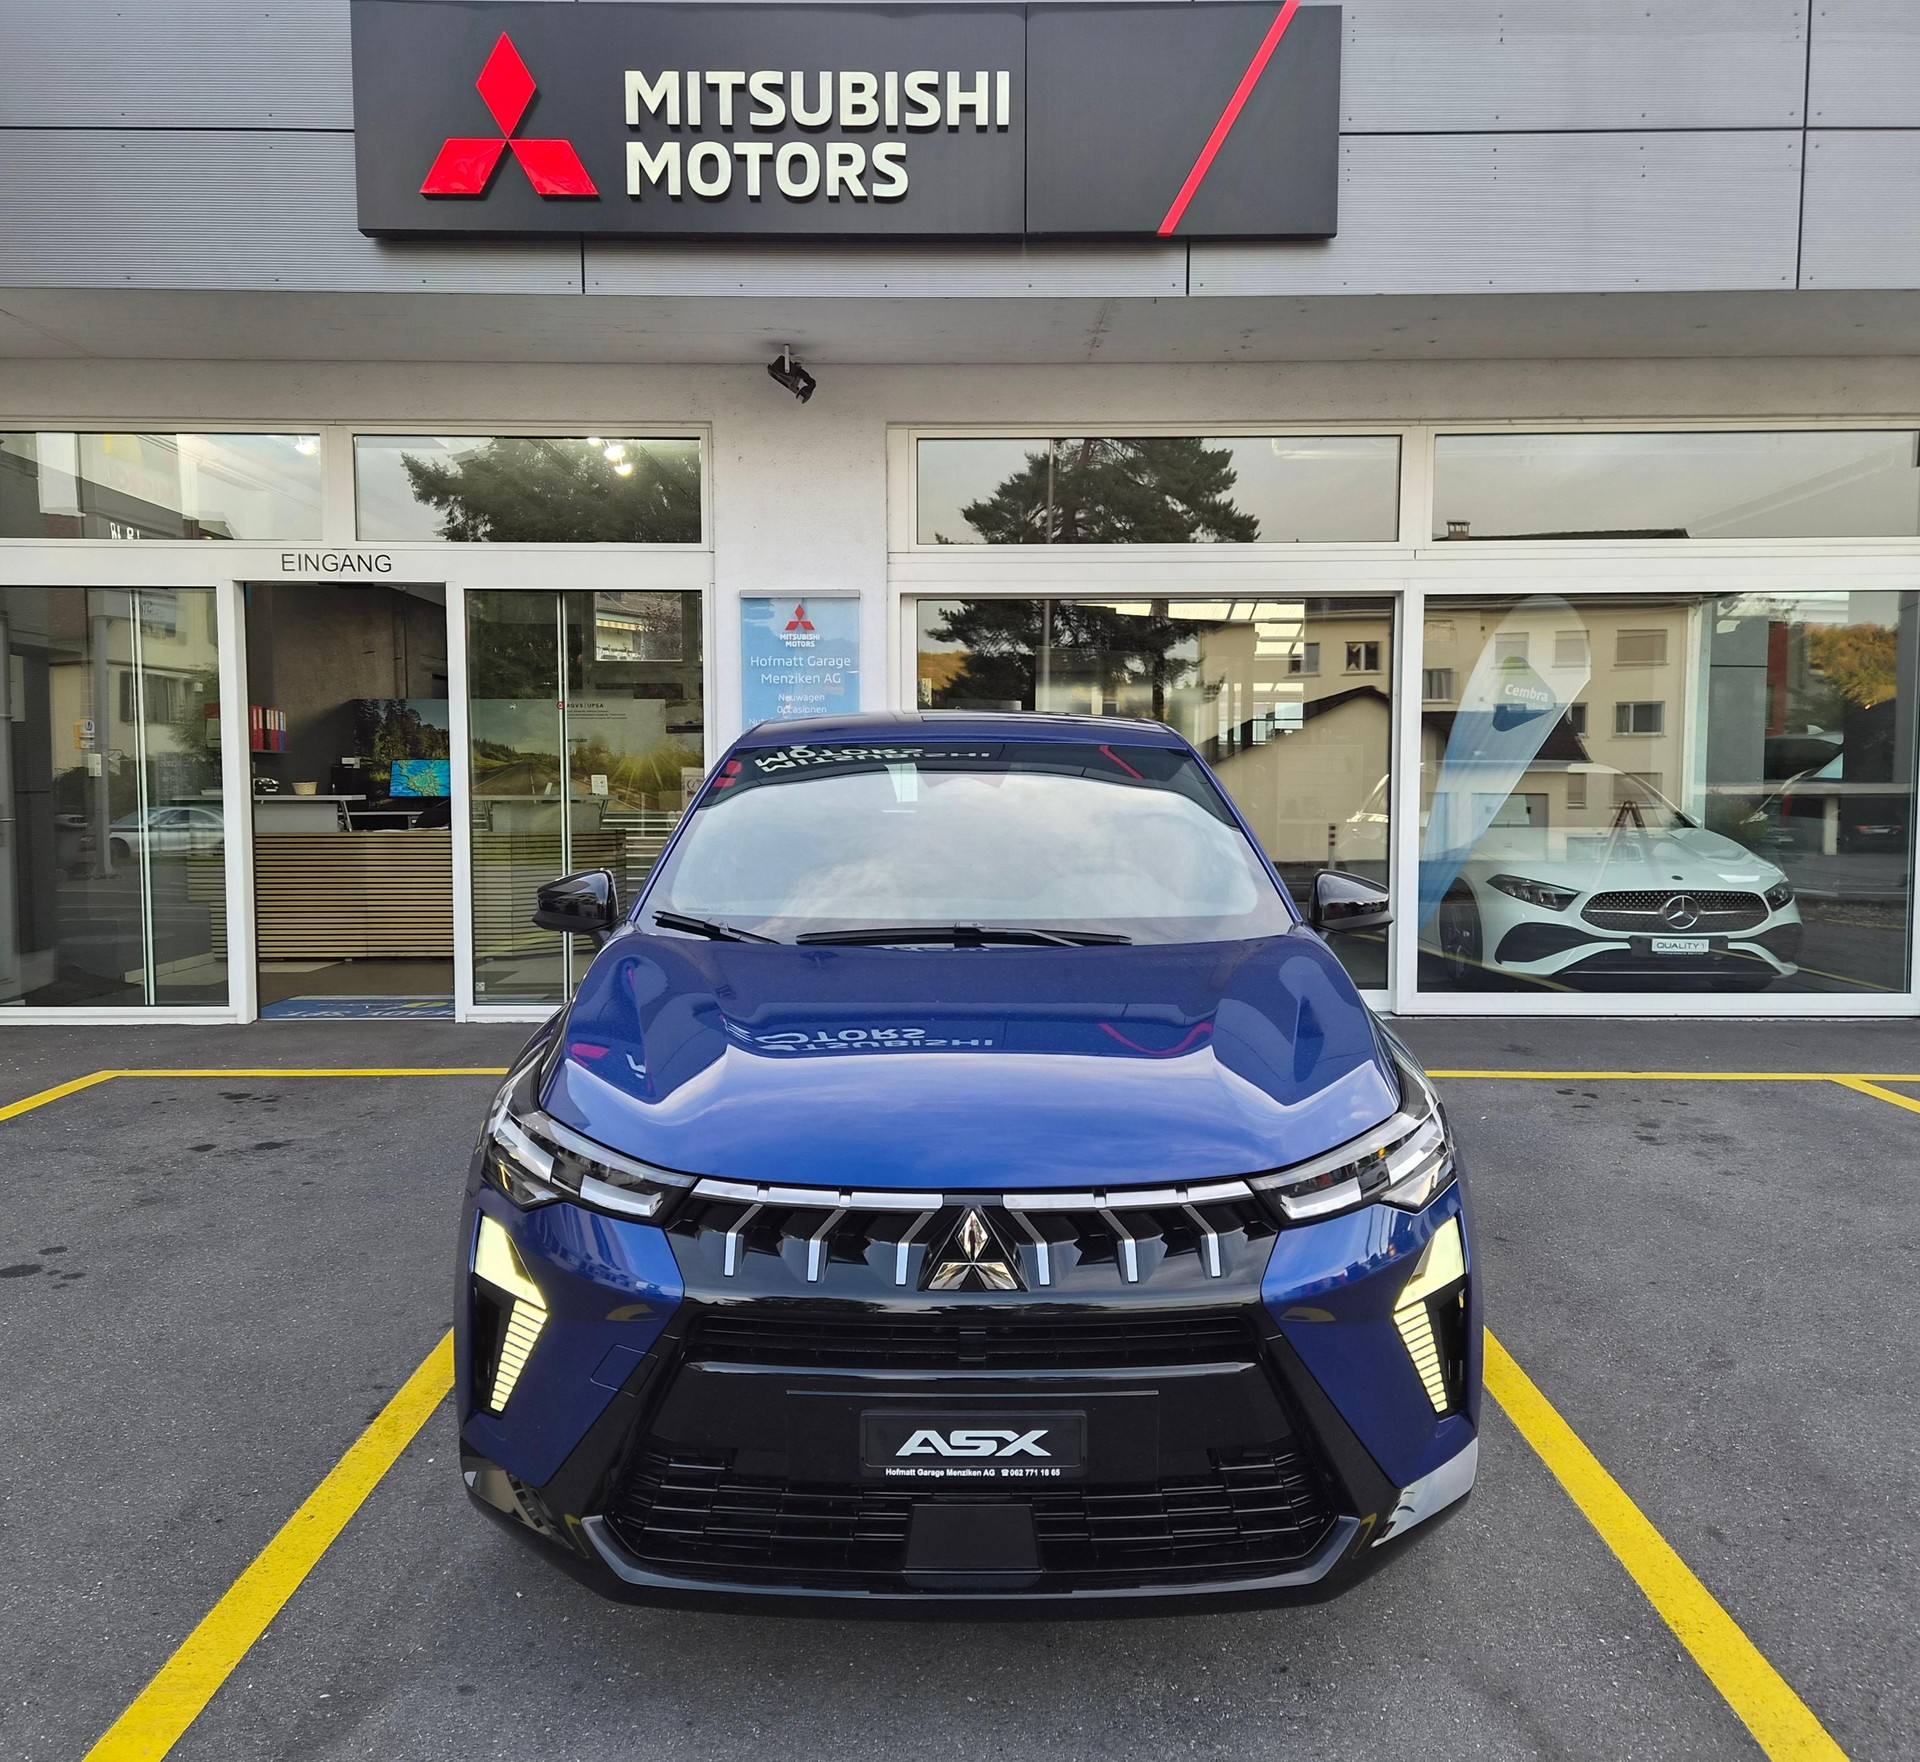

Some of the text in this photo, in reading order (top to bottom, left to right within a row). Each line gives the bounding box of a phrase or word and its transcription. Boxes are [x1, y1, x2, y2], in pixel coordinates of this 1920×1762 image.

[624, 70, 1010, 127] MITSUBISHI
[626, 141, 909, 197] MOTORS
[281, 553, 392, 573] EINGANG
[750, 655, 851, 668] Hofmatt Garage
[761, 673, 841, 684] Menziken AG
[778, 694, 825, 703] Neuwagen
[1505, 684, 1548, 702] Cembra
[776, 705, 827, 714] Occasionen
[895, 1430, 1052, 1457] ASX
[885, 1468, 916, 1476] Hofmatt
[917, 1468, 945, 1478] Garage
[946, 1468, 982, 1476] Menziken
[983, 1468, 996, 1476] AG
[1025, 1468, 1039, 1476] 771
